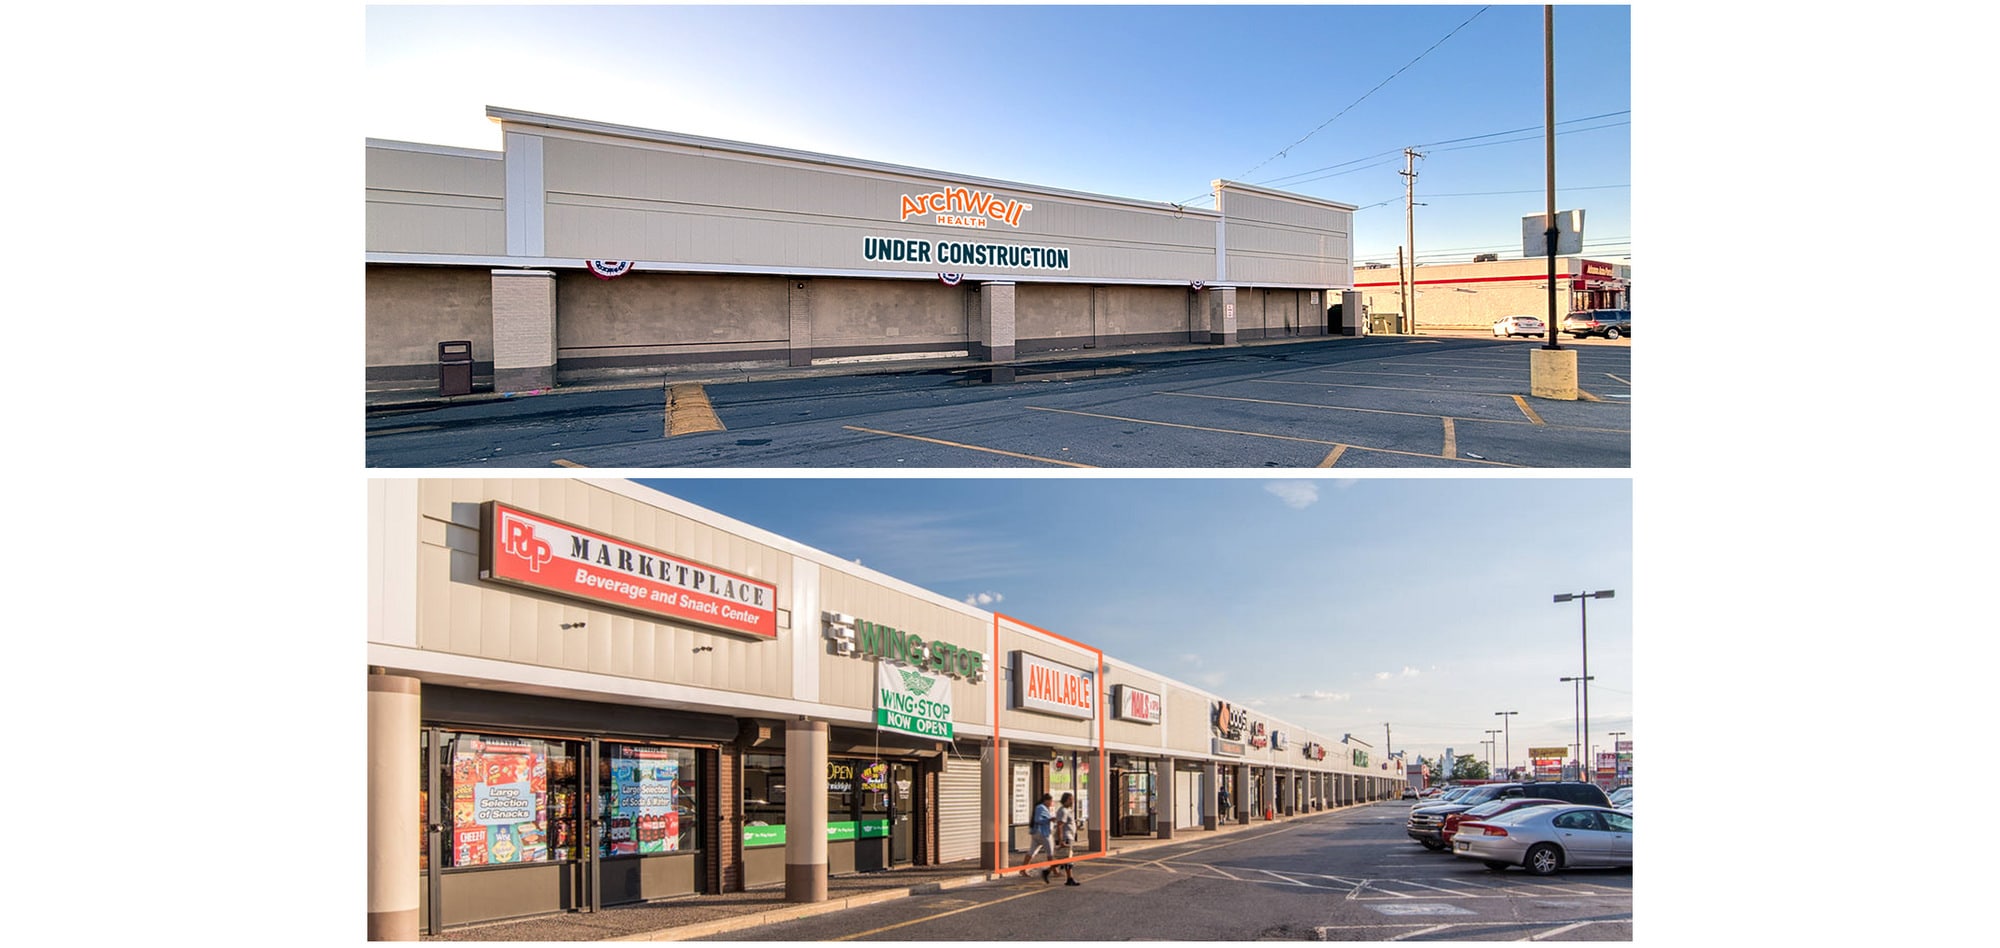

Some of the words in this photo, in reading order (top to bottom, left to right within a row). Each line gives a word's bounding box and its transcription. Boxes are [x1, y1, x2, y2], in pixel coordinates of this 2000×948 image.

[570, 535, 764, 606] MARKETPLACE
[574, 568, 648, 598] Beverage
[650, 588, 677, 605] and
[679, 594, 719, 615] Snack
[721, 604, 760, 625] Center
[1131, 690, 1149, 719] NAILS
[887, 712, 912, 729] NOW
[916, 719, 948, 736] OPEN
[827, 762, 853, 780] OPEN
[490, 787, 520, 797] Large
[641, 784, 669, 794] Selection
[480, 799, 528, 808] Selection
[479, 810, 491, 819] of
[492, 810, 529, 819] Snacks
